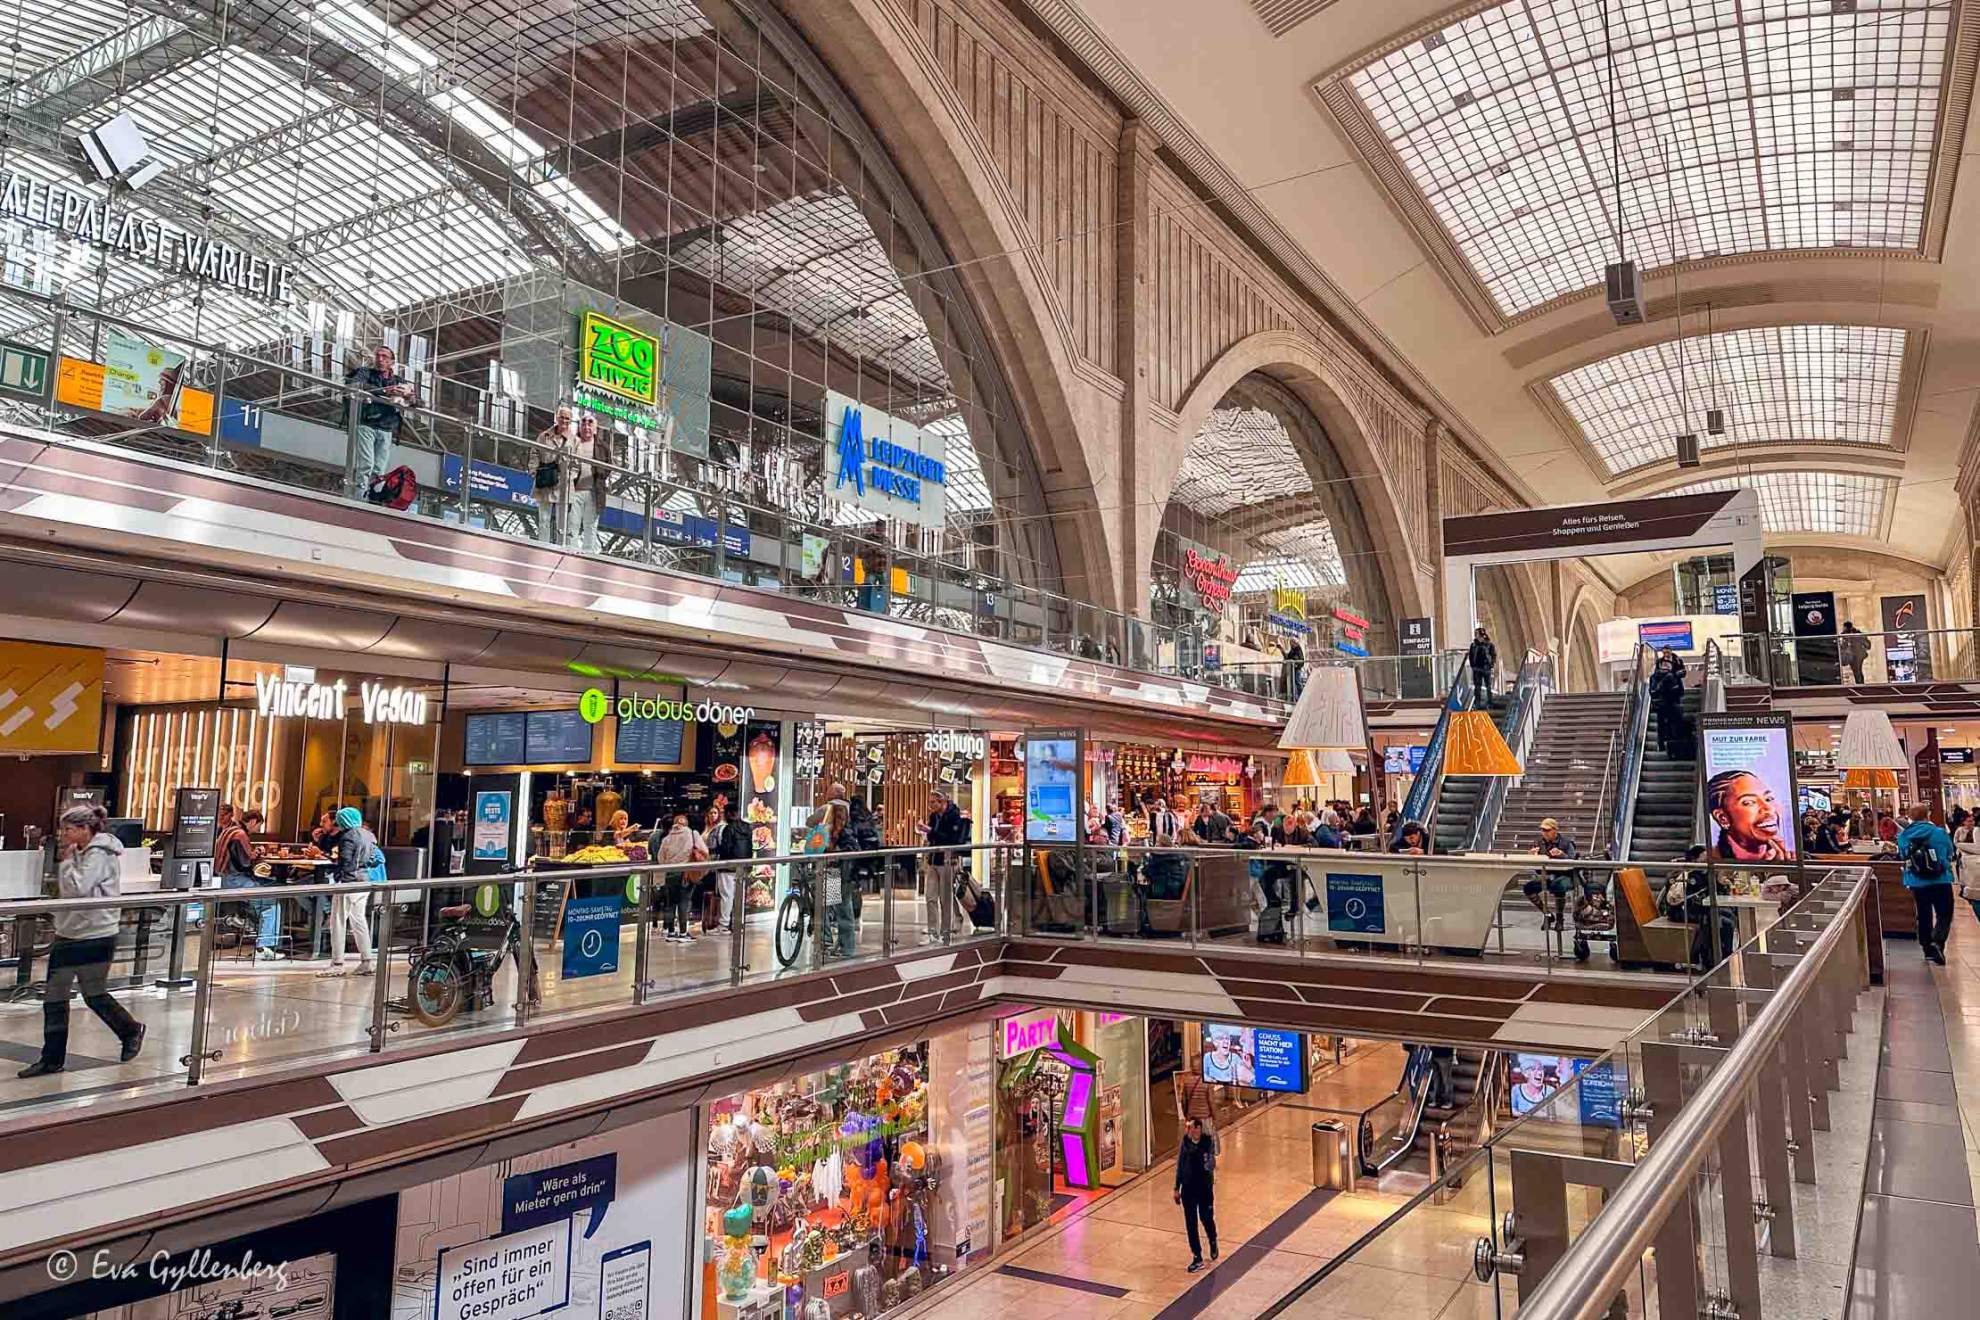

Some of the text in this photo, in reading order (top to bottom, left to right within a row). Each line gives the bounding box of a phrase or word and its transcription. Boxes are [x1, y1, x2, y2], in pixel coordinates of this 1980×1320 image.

[591, 325, 653, 370] ZOO
[590, 358, 652, 395] LEIPZIG
[240, 404, 261, 429] 11
[872, 437, 945, 484] LEIPZIGER
[872, 466, 921, 504] MESSE
[1552, 526, 1586, 536] Shoppen
[1562, 513, 1626, 526] Alles fürs Reisen,
[256, 672, 427, 725] Vincent Vegan
[1756, 716, 1786, 725] NEWS
[1258, 1039, 1279, 1047] MACHT
[571, 1171, 587, 1184] als
[515, 1180, 606, 1214] Mieter gern drin“
[453, 1239, 554, 1284] „Sind immer
[452, 1259, 552, 1302] offen für ein
[460, 1279, 544, 1320] Gespräch“
